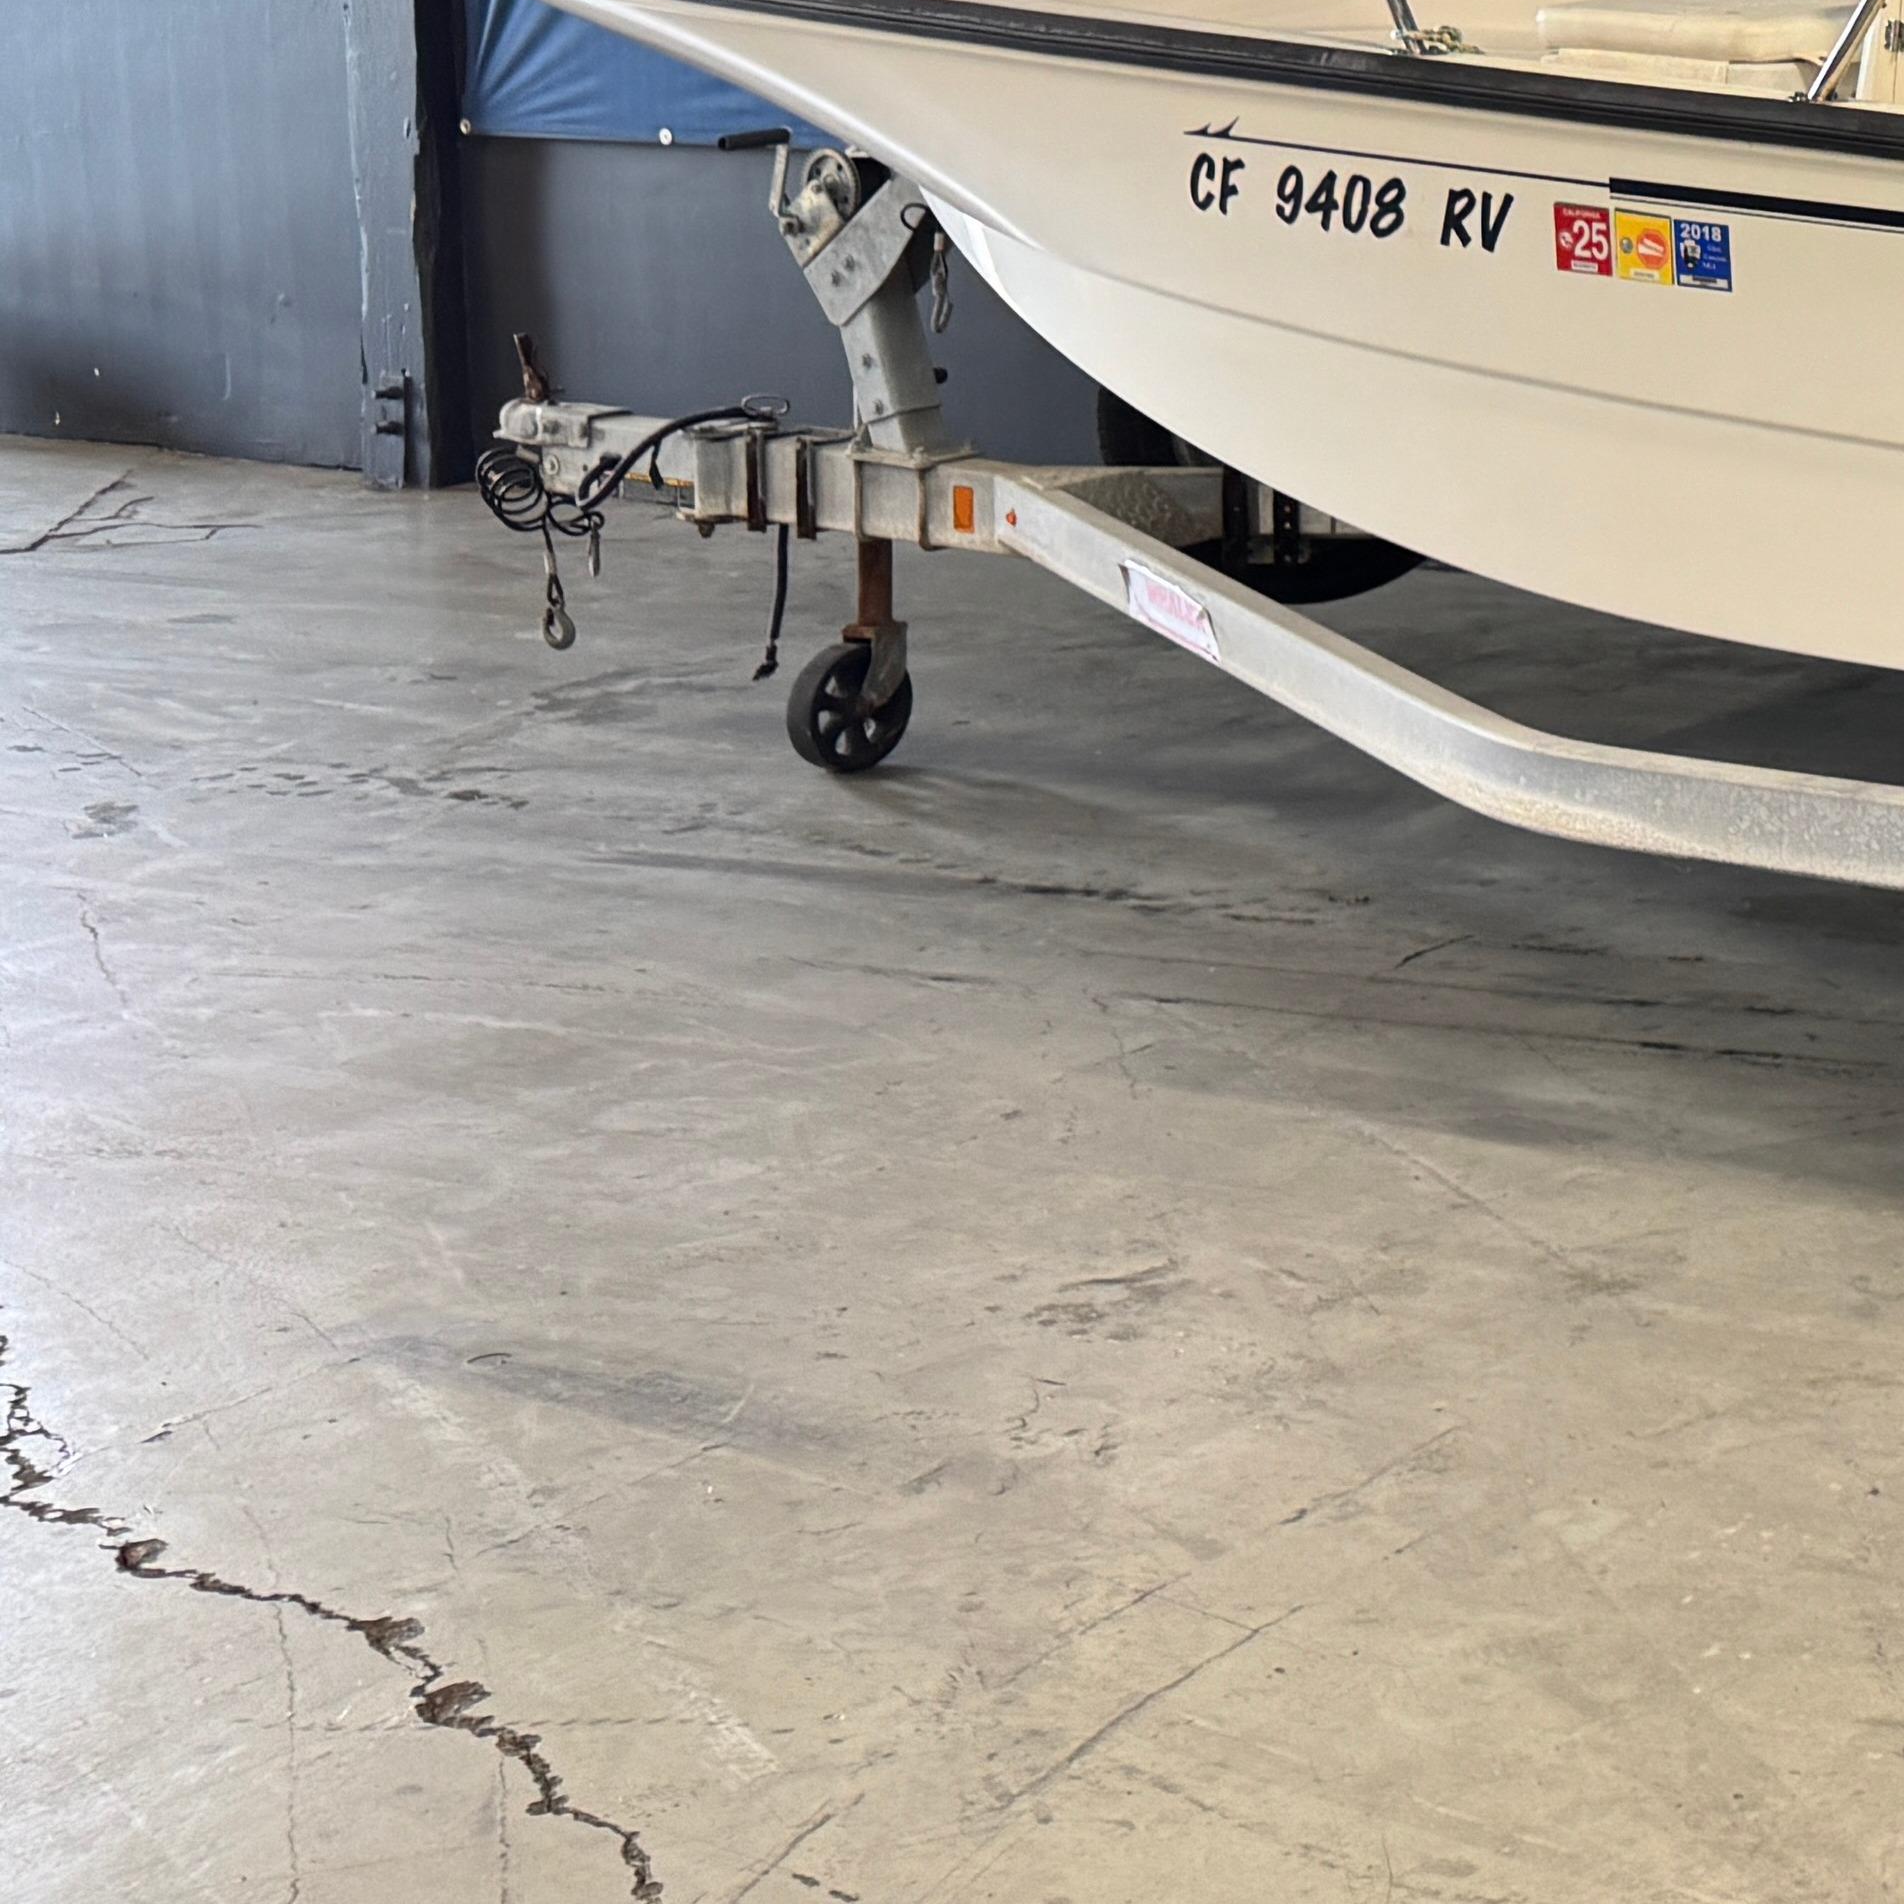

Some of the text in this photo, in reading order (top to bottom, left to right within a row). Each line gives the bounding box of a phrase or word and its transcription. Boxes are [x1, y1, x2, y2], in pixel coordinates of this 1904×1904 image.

[1190, 153, 1514, 252] CF 9408 RV
[1573, 219, 1609, 261] 25
[1680, 222, 1722, 242] 2018
